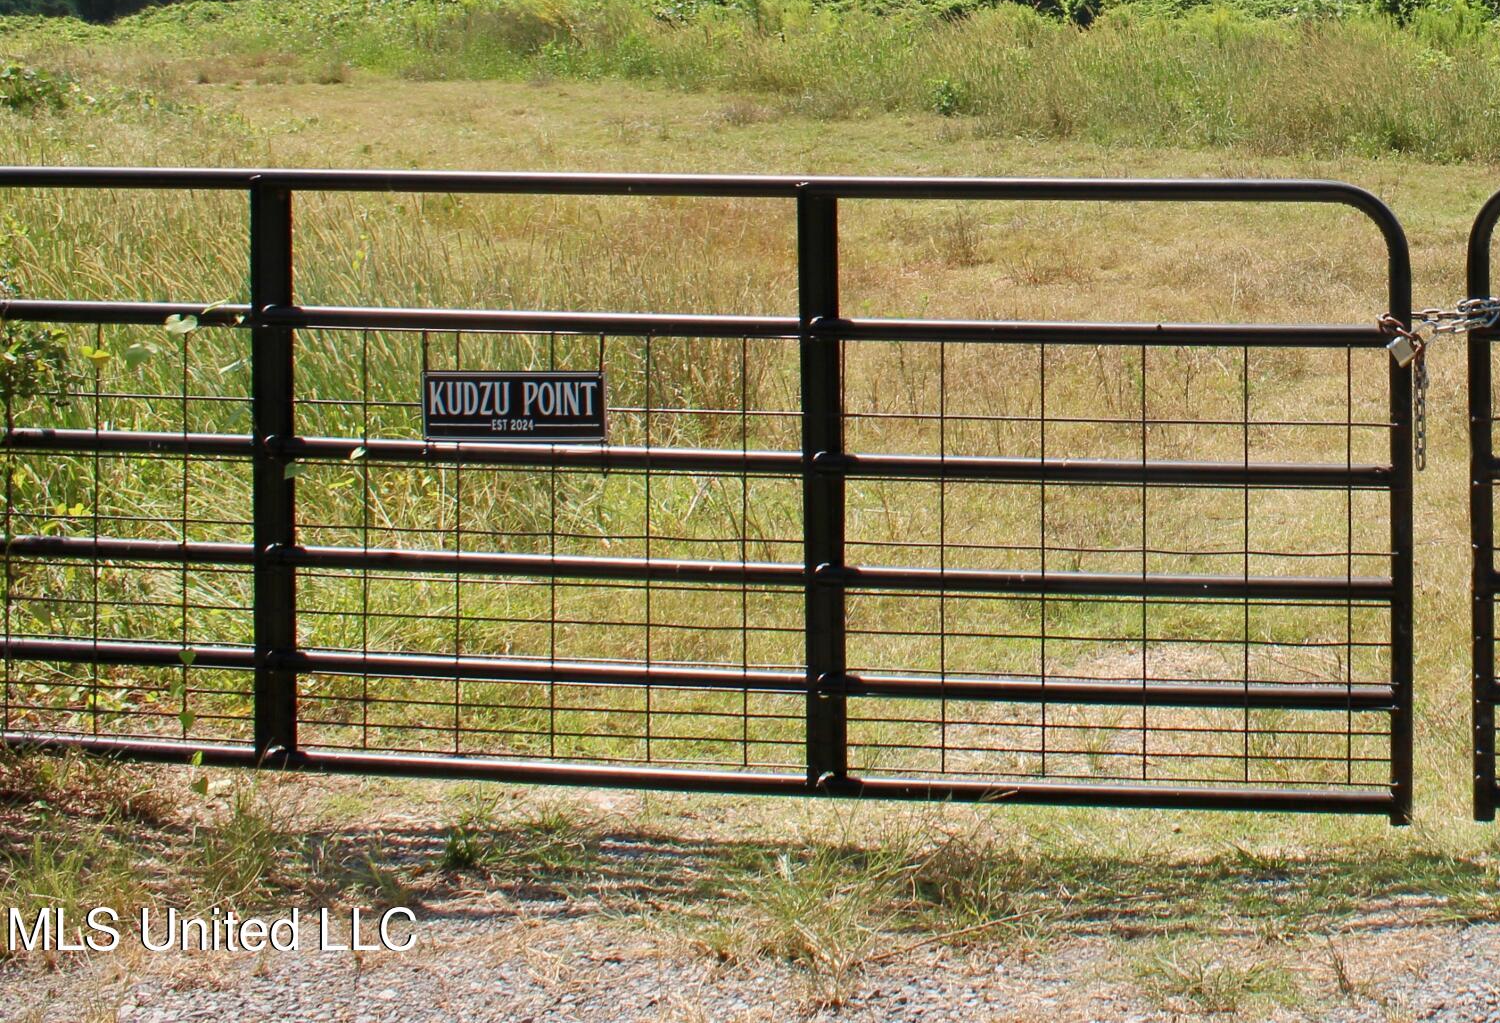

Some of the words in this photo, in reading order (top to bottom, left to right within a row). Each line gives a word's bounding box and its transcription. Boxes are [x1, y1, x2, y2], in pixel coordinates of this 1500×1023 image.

[429, 381, 510, 416] KUDZU
[523, 381, 597, 416] POINT
[491, 419, 507, 431] EST
[510, 419, 534, 431] 2024
